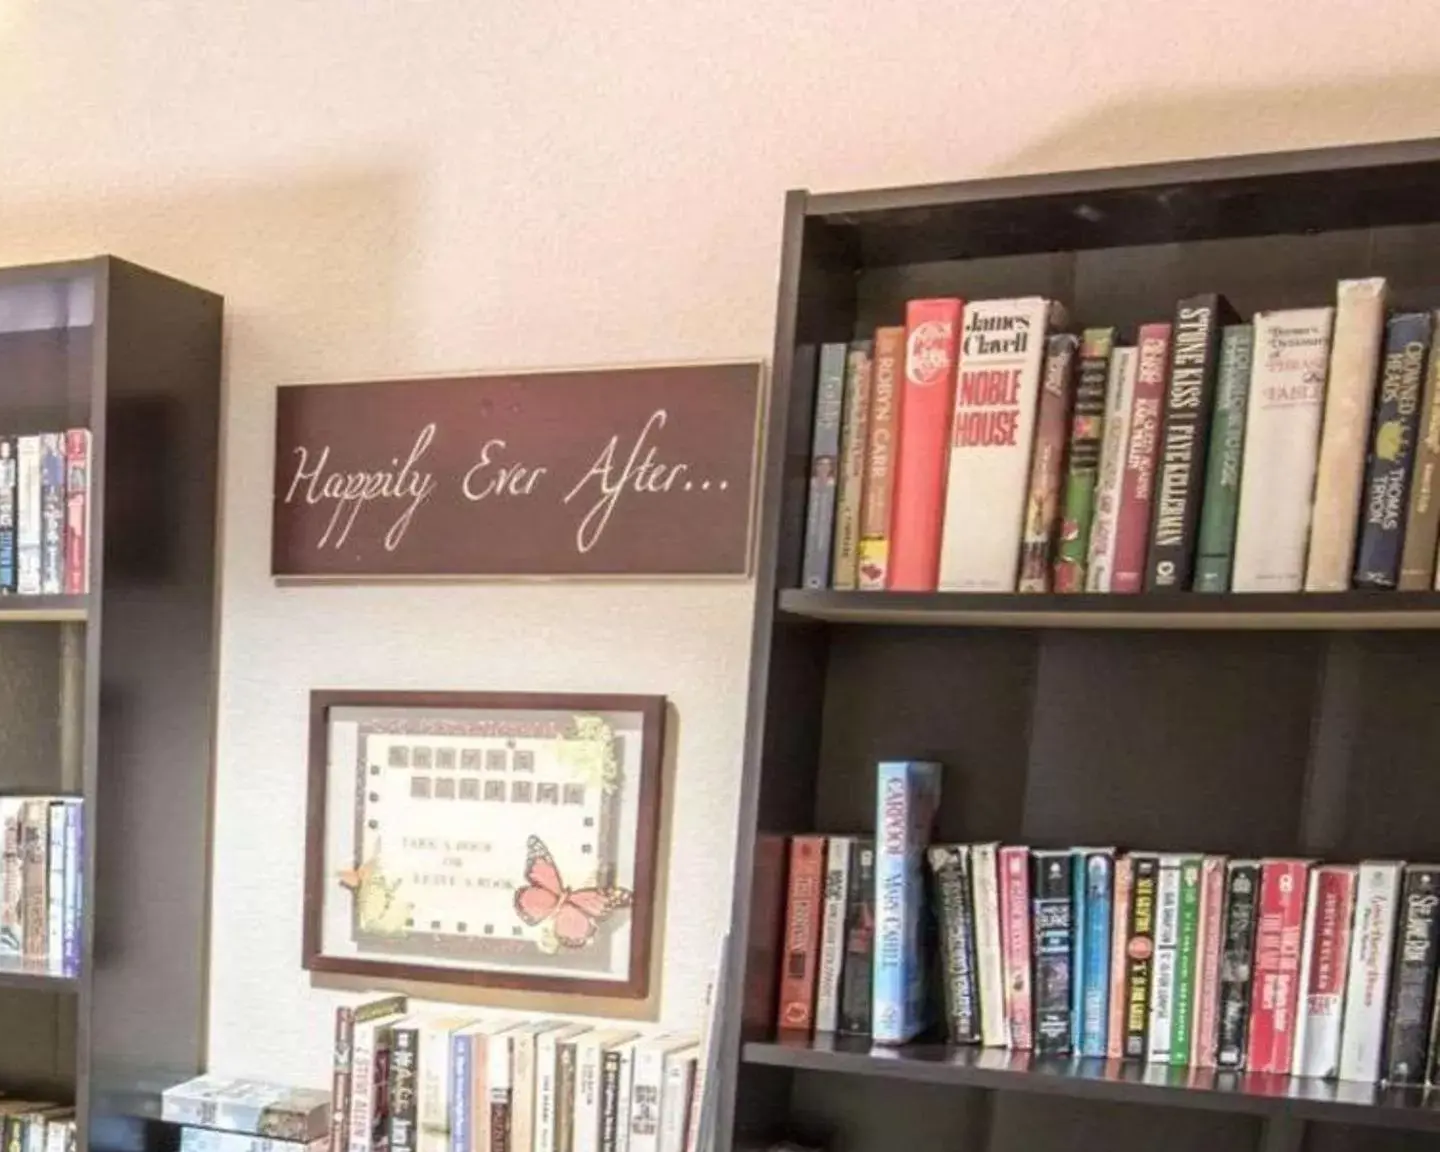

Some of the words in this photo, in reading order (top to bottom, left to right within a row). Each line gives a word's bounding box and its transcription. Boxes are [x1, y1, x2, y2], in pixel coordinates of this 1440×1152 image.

[963, 332, 1028, 356] Clavell
[965, 312, 1030, 332] James
[1174, 307, 1210, 364] STONE
[873, 357, 897, 421] ROBYN
[959, 370, 1022, 407] NOBLE
[1170, 367, 1205, 409] KISS
[953, 410, 1020, 448] HOUSE
[870, 428, 892, 478] CARR
[285, 423, 436, 551] Happily
[462, 439, 547, 500] Ever
[1154, 464, 1192, 546] KELLERMAN
